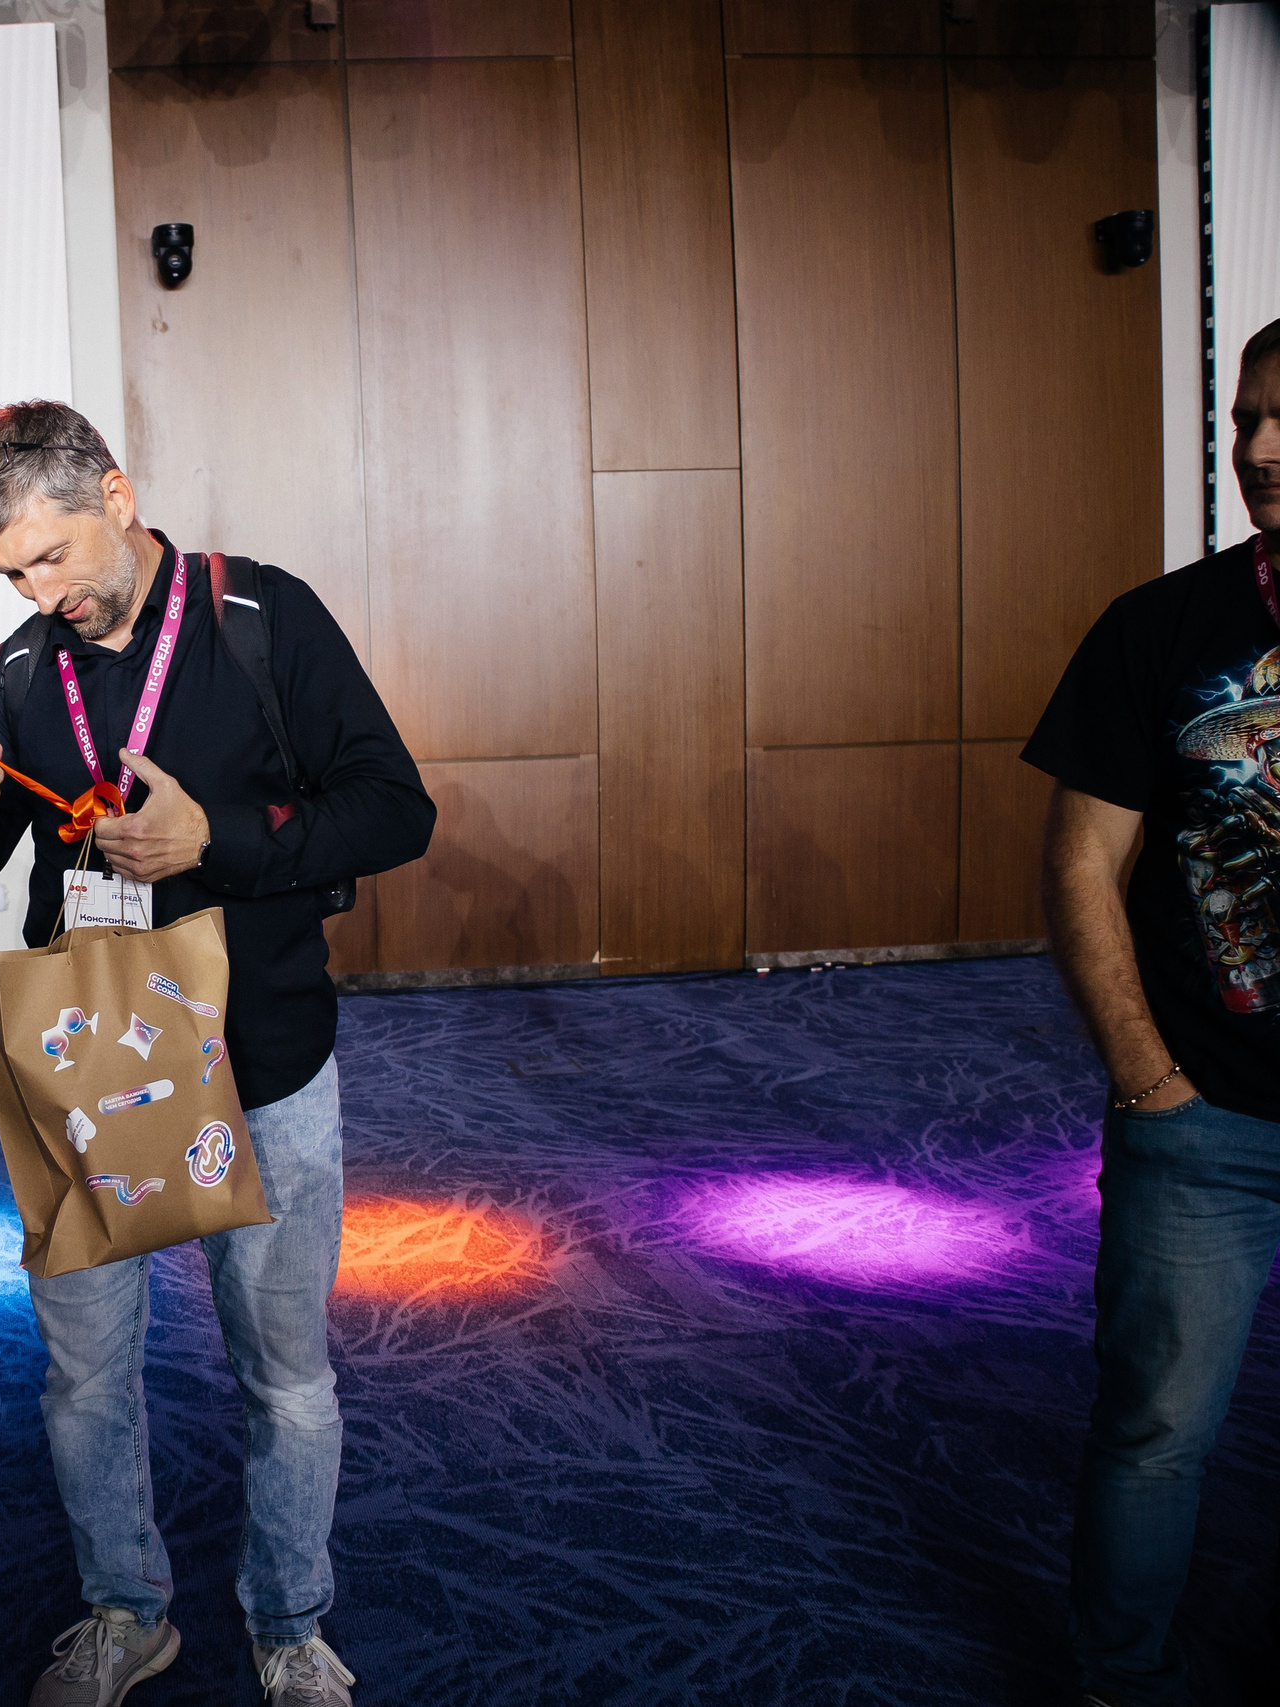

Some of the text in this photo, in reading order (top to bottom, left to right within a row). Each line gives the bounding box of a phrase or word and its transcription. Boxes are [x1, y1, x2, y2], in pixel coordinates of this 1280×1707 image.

[135, 705, 151, 733] OCS
[146, 634, 173, 693] IT-СРЕДА
[168, 594, 181, 620] OCS
[66, 680, 79, 705] OCS
[74, 714, 97, 770] IT-СРЕДА
[151, 975, 177, 991] СПАСИ
